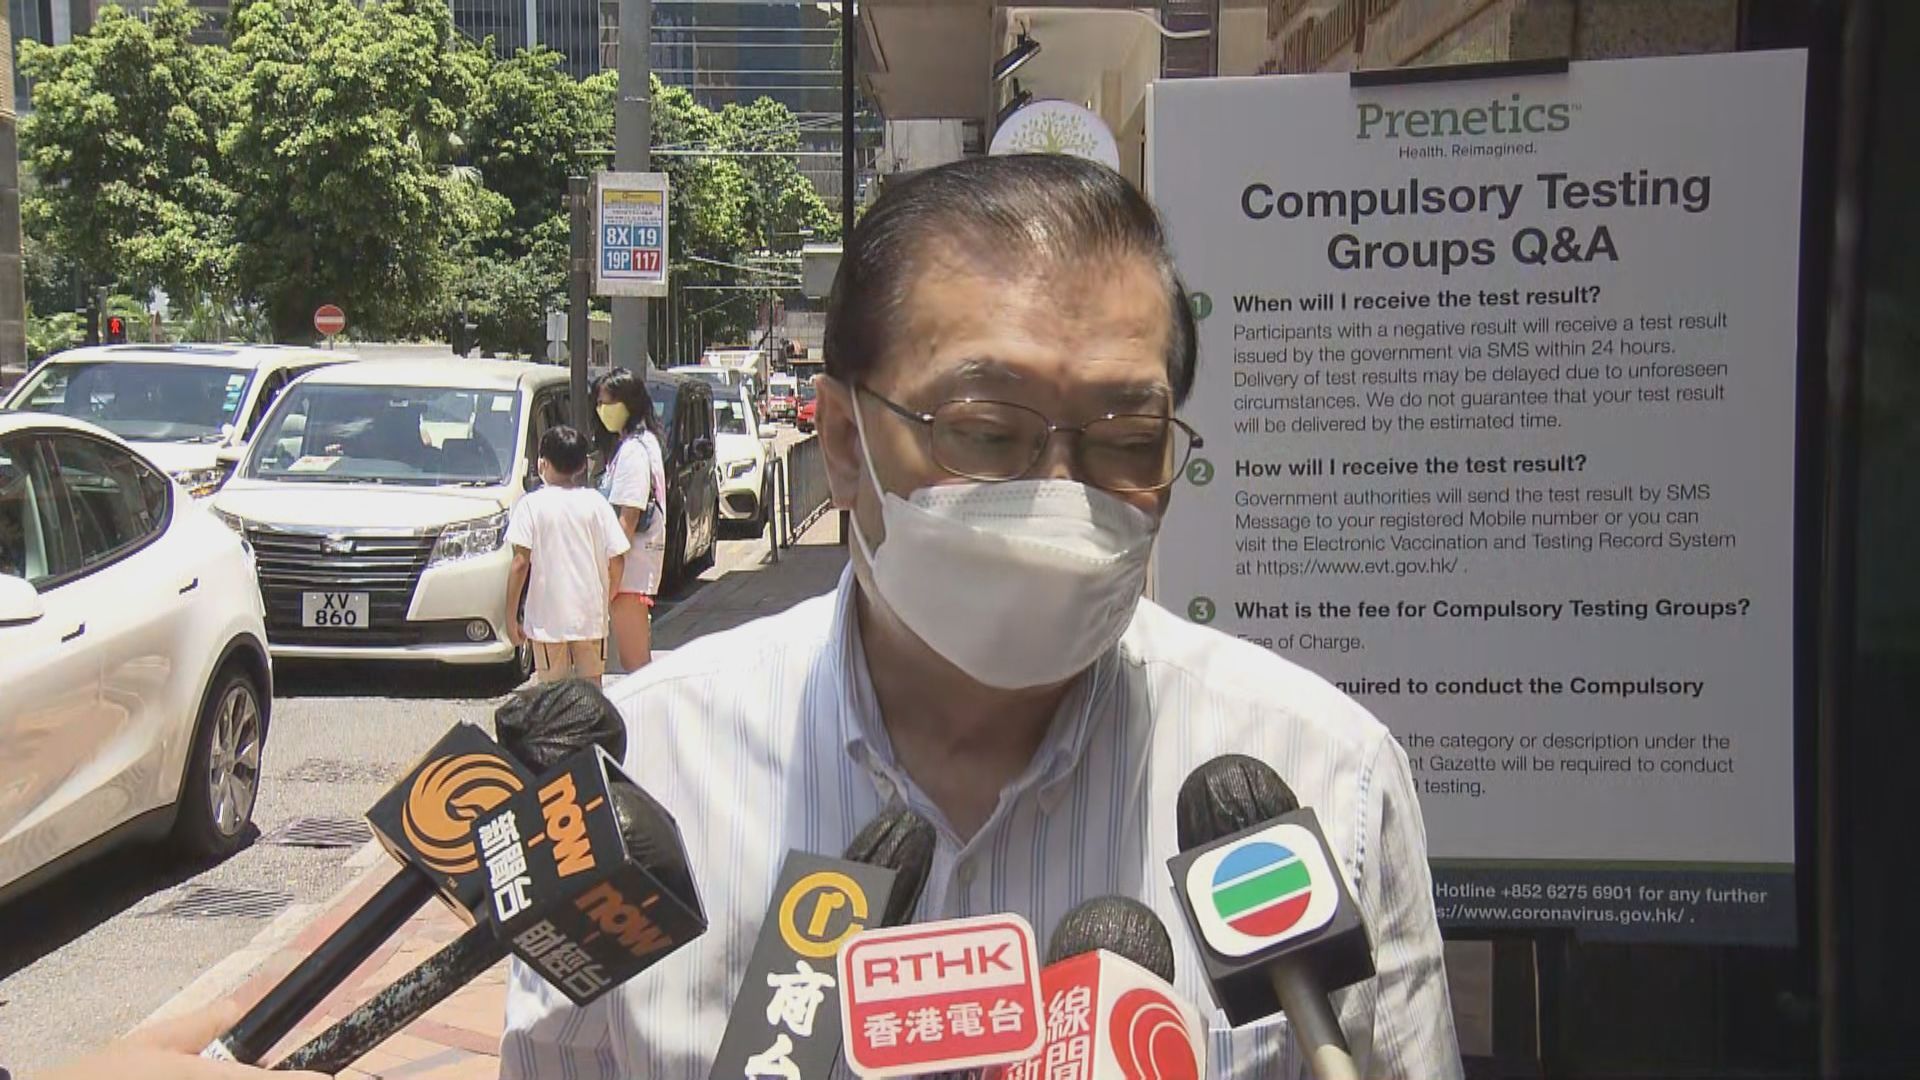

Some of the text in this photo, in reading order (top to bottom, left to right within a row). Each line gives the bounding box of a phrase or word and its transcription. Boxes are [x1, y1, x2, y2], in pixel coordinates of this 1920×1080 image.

[1357, 94, 1573, 139] Prenetics
[1399, 142, 1536, 158] Health. Reimagined.
[1241, 169, 1710, 224] Compulsory Testing
[607, 227, 657, 246] 8X 19
[607, 250, 658, 270] 19P 117
[1328, 225, 1619, 274] Groups Q&A
[1233, 294, 1292, 313] When
[1299, 293, 1333, 311] will
[1341, 292, 1346, 310] I
[1354, 291, 1430, 310] receive
[1437, 290, 1471, 307] the
[1478, 288, 1519, 307] test
[1526, 286, 1600, 305] result?
[1234, 312, 1727, 343] Participants with a negative result will receive a test result
[1234, 338, 1675, 366] issued by the government via SMS within 24 hours.
[1234, 362, 1727, 389] Delivery of test results may be delayed due to unforeseen
[1234, 384, 1724, 410] circumstances. We do not guarantee that your test result
[1234, 412, 1562, 434] will be delivered by the estimated time.
[1193, 454, 1587, 481] 2 How will I receive the test result?
[1235, 484, 1710, 507] Government authorities will send the test result by SMS
[1236, 510, 1698, 532] Message to your registered Mobile number or you can
[1235, 532, 1735, 552] visit the Electronic Vaccination and Testing Record System
[1236, 557, 1458, 578] at https://www.evt.gov.hk/
[323, 593, 349, 609] XV
[1195, 598, 1750, 621] 3 What is the fee for Compulsory Testing Groups?
[315, 610, 357, 625] 860
[1278, 634, 1295, 650] of
[1299, 634, 1364, 653] Charge.
[1407, 678, 1428, 695] to
[1435, 677, 1523, 695] conduct
[1528, 677, 1563, 695] the
[1570, 677, 1704, 698] Compulsory
[1408, 733, 1435, 748] the
[1440, 733, 1514, 752] category
[1520, 736, 1538, 749] or
[1543, 732, 1638, 752] description
[1645, 733, 1696, 749] under
[1703, 733, 1730, 749] the
[1430, 755, 1496, 771] Gazette
[1501, 755, 1527, 771] will
[1533, 756, 1554, 771] be
[1561, 756, 1631, 775] required
[1638, 757, 1654, 773] to
[1660, 757, 1734, 773] conduct
[1424, 778, 1485, 797] testing.
[537, 772, 597, 878] now
[478, 809, 533, 922] 新聞台
[1437, 883, 1767, 905] Hotline +852 6275 6901 for any further
[574, 881, 674, 958] now
[863, 942, 1014, 988] RTHK
[863, 998, 1025, 1049] 香港電台
